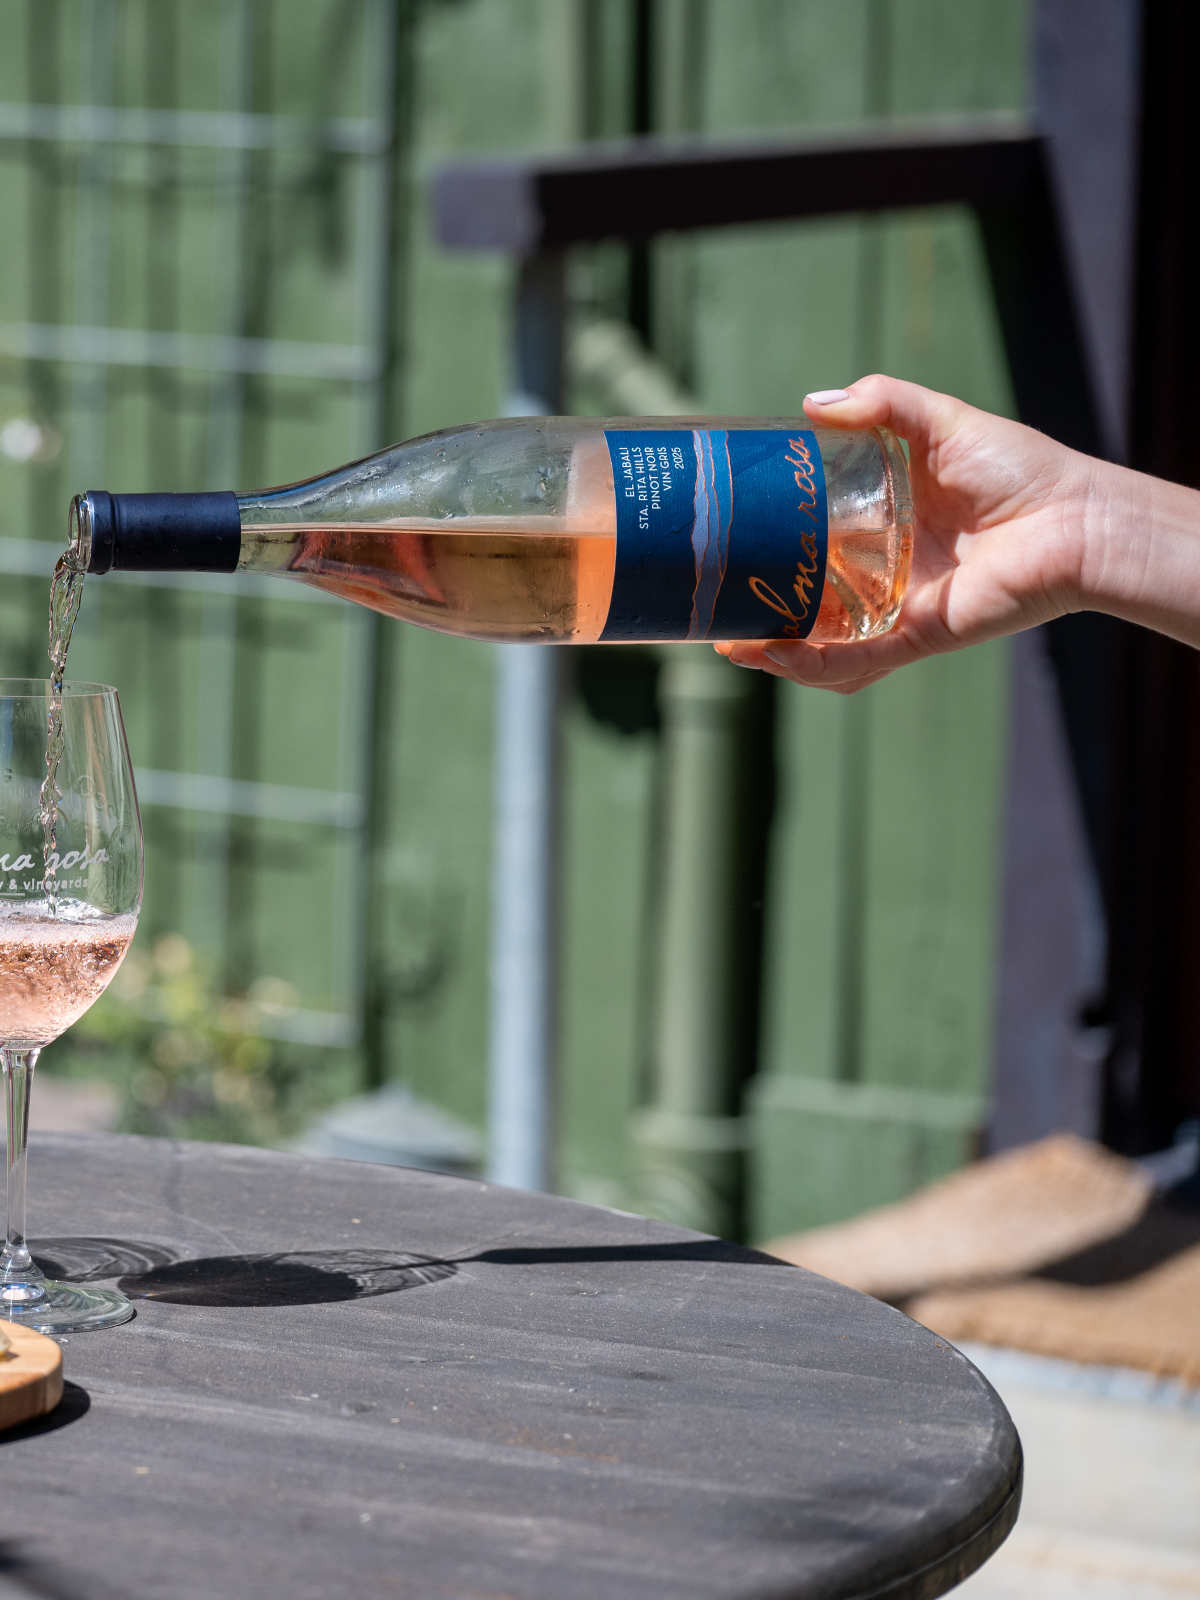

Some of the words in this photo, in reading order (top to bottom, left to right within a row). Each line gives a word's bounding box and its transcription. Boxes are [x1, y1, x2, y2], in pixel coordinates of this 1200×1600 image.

[619, 447, 633, 481] JABALI
[632, 446, 645, 474] HILLS
[645, 447, 658, 471] NOIR
[657, 447, 670, 469] GRIS
[671, 447, 684, 469] 2025
[625, 484, 635, 498] EL
[637, 476, 648, 501] RITA
[649, 474, 661, 510] PINOT
[662, 472, 672, 491] VIN
[639, 504, 649, 529] STA.
[748, 529, 817, 637] alma
[784, 437, 819, 523] rosa
[44, 843, 109, 871] rosa
[9, 879, 17, 890] &
[23, 877, 88, 891] vineyards
